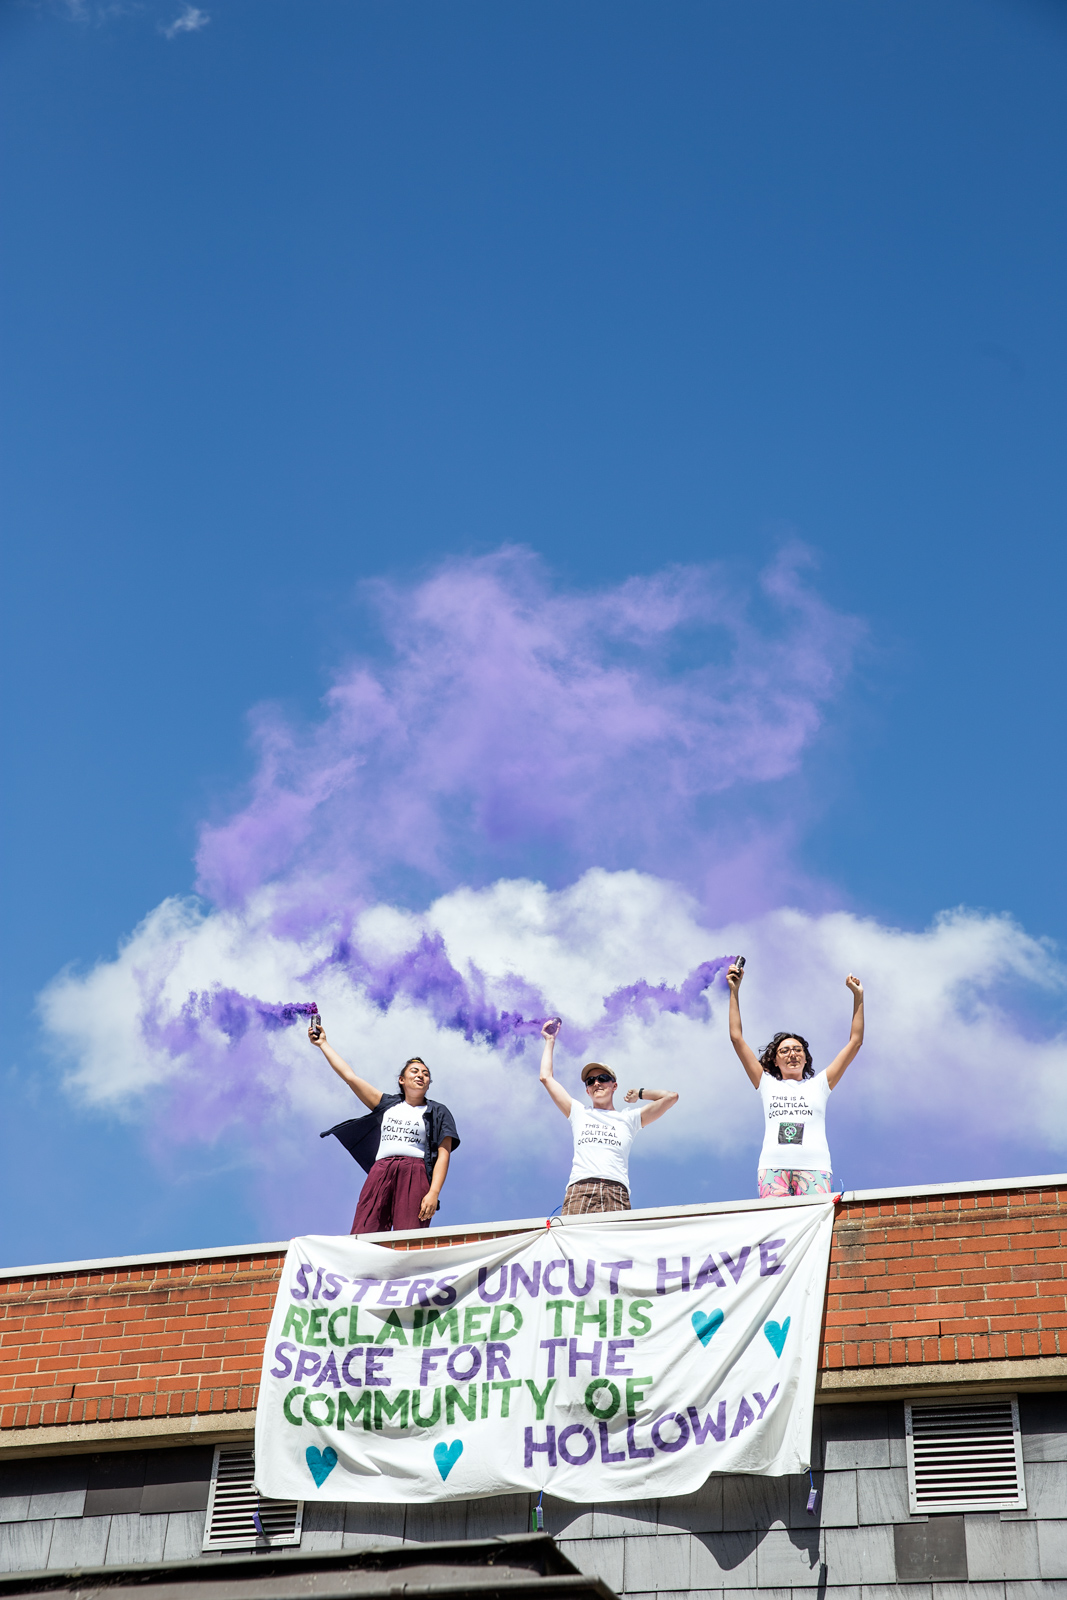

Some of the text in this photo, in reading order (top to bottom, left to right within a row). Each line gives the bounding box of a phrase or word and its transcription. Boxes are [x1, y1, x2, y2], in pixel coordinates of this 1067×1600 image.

[387, 1117, 403, 1125] THIS
[768, 1109, 813, 1119] OCCUPATION
[383, 1125, 420, 1136] POLITICAL
[577, 1137, 622, 1146] OCCUPATION
[581, 1130, 618, 1138] POLITICAL
[290, 1238, 786, 1307] SISTERS UNCUT HAVE
[281, 1299, 653, 1347] RECLAIMED THIS
[270, 1338, 635, 1389] SPACE FOR THE
[283, 1376, 653, 1431] COMMUNITY OF
[524, 1382, 780, 1468] HOLLOWAY
